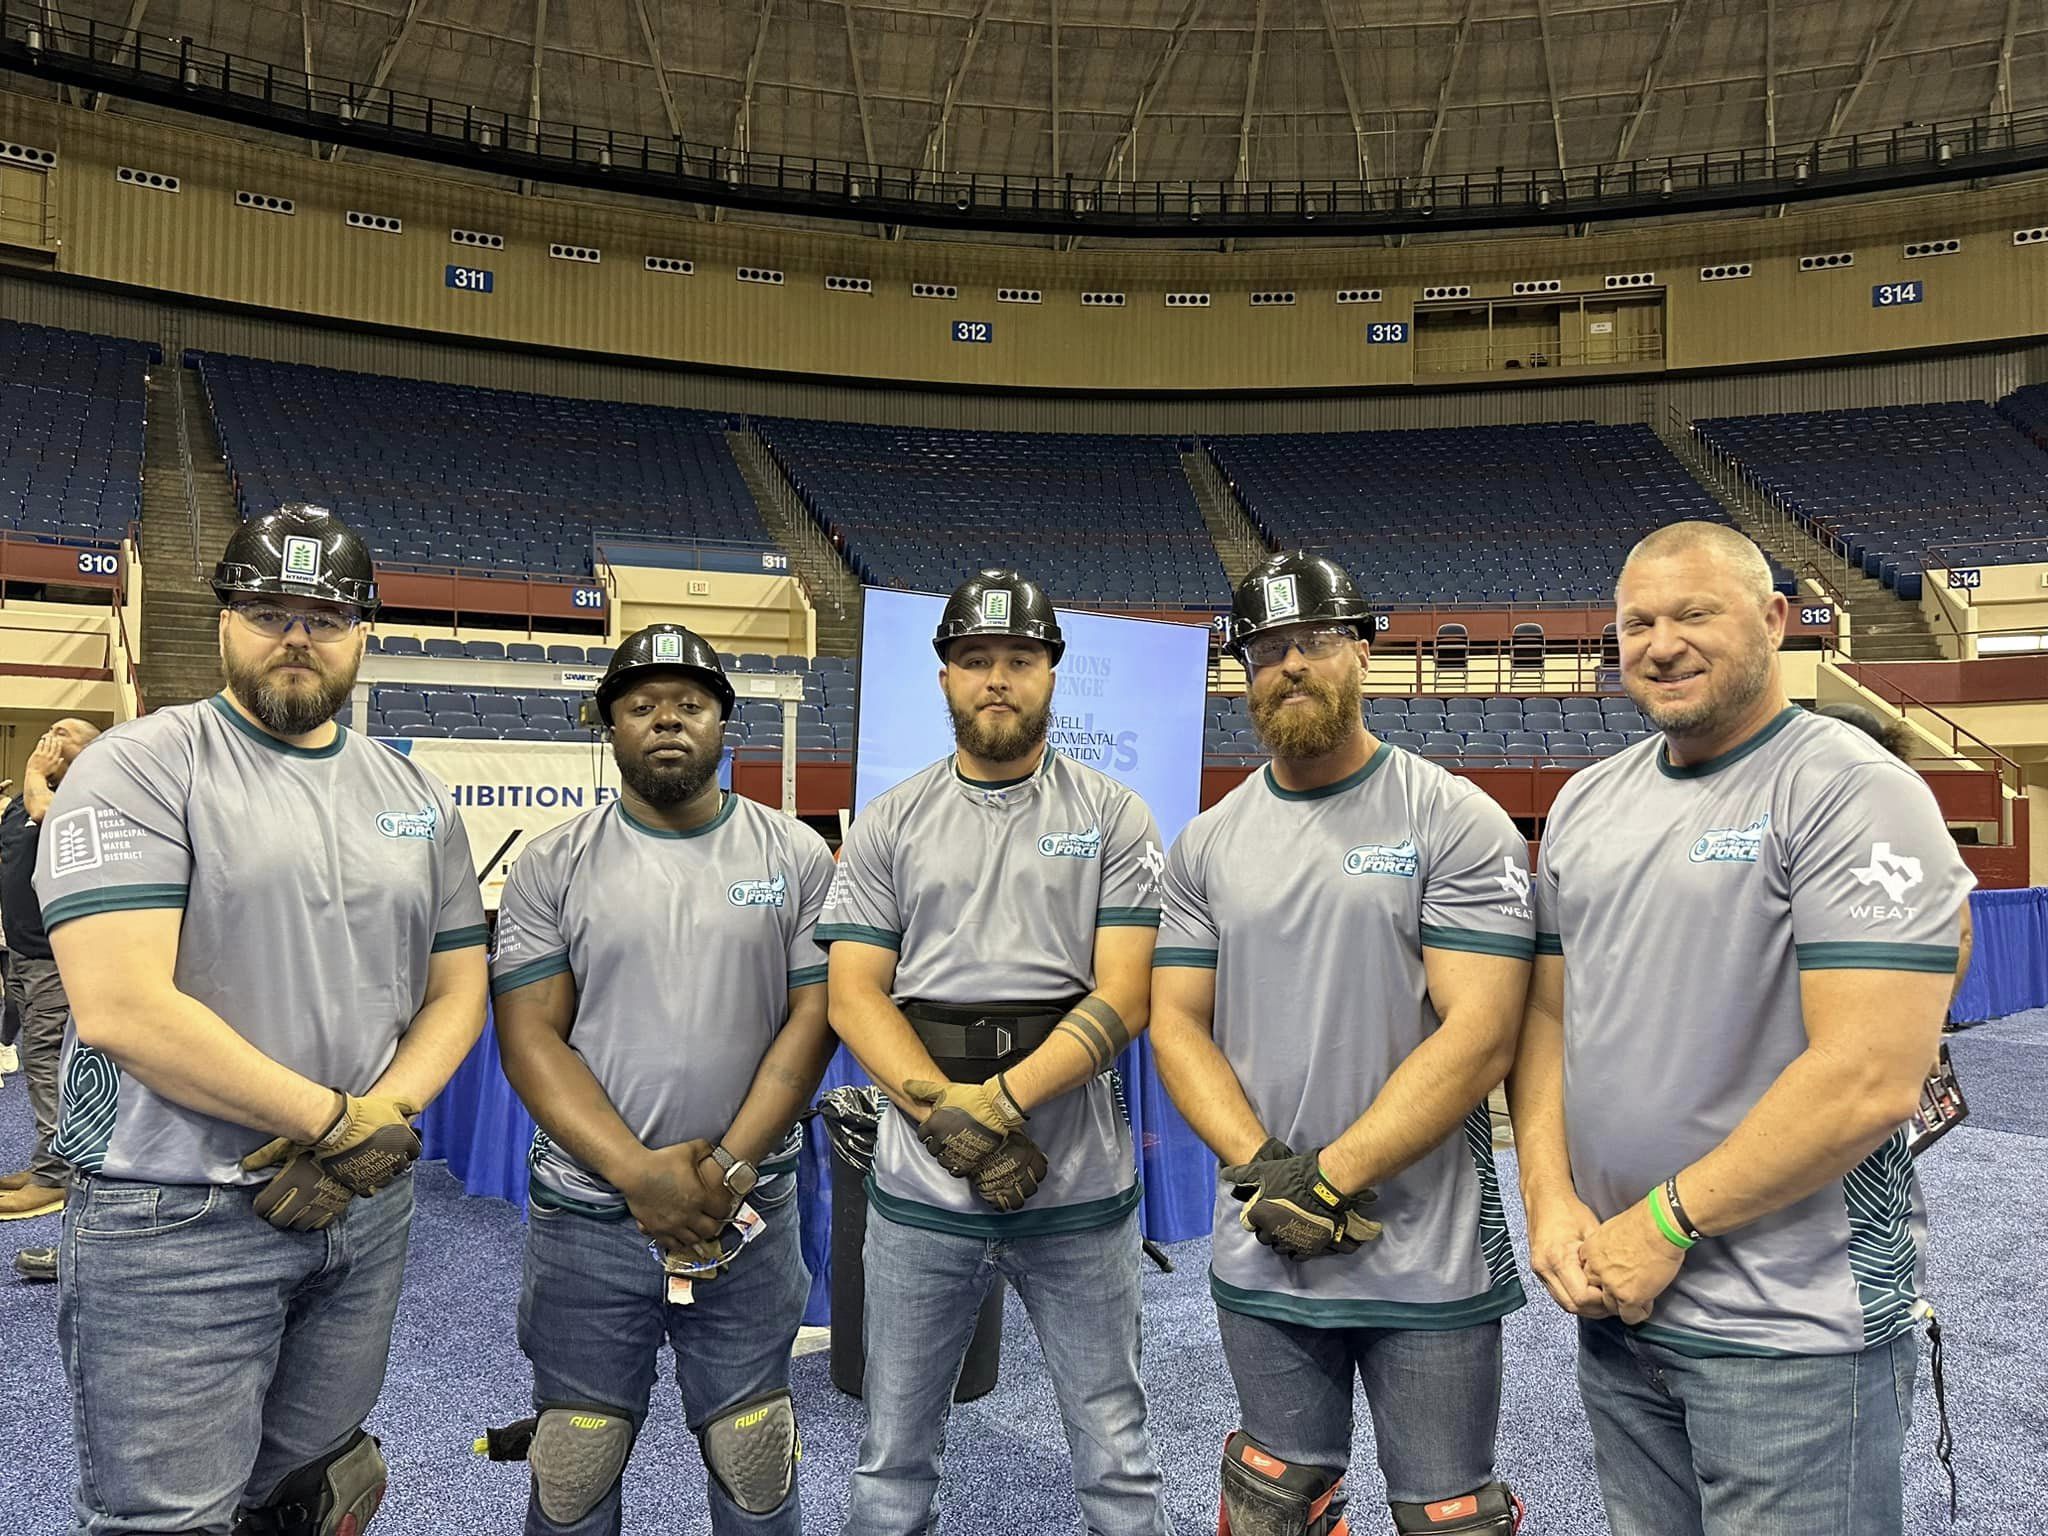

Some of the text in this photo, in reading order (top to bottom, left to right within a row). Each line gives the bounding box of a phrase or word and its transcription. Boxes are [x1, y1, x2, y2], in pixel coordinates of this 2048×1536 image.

[455, 269, 485, 290] 311
[1880, 284, 1916, 304] 314
[958, 323, 987, 341] 312
[1372, 324, 1402, 342] 313
[79, 553, 118, 574] 310
[765, 555, 787, 569] 311
[1950, 571, 1979, 588] 314
[692, 582, 707, 593] EXIT
[575, 590, 601, 607] 311
[1801, 608, 1831, 624] 313
[1375, 617, 1389, 631] 13
[451, 784, 584, 807] HIBITION
[99, 819, 125, 829] TEXAS
[101, 829, 148, 840] MUNICIPAL
[102, 841, 131, 851] WATER
[1056, 845, 1098, 857] FORCE
[1708, 846, 1760, 860] FORCE
[104, 851, 142, 862] DISTRICT
[1366, 855, 1416, 865] CENTRIFUGAL
[1363, 861, 1416, 876] FORCE
[1498, 905, 1535, 921] WEAT
[1849, 905, 1919, 920] WEAT
[332, 1148, 386, 1177] Mechanix
[348, 1152, 401, 1183] Mechanix
[569, 1416, 607, 1430] AWP
[734, 1407, 769, 1430] AWP
